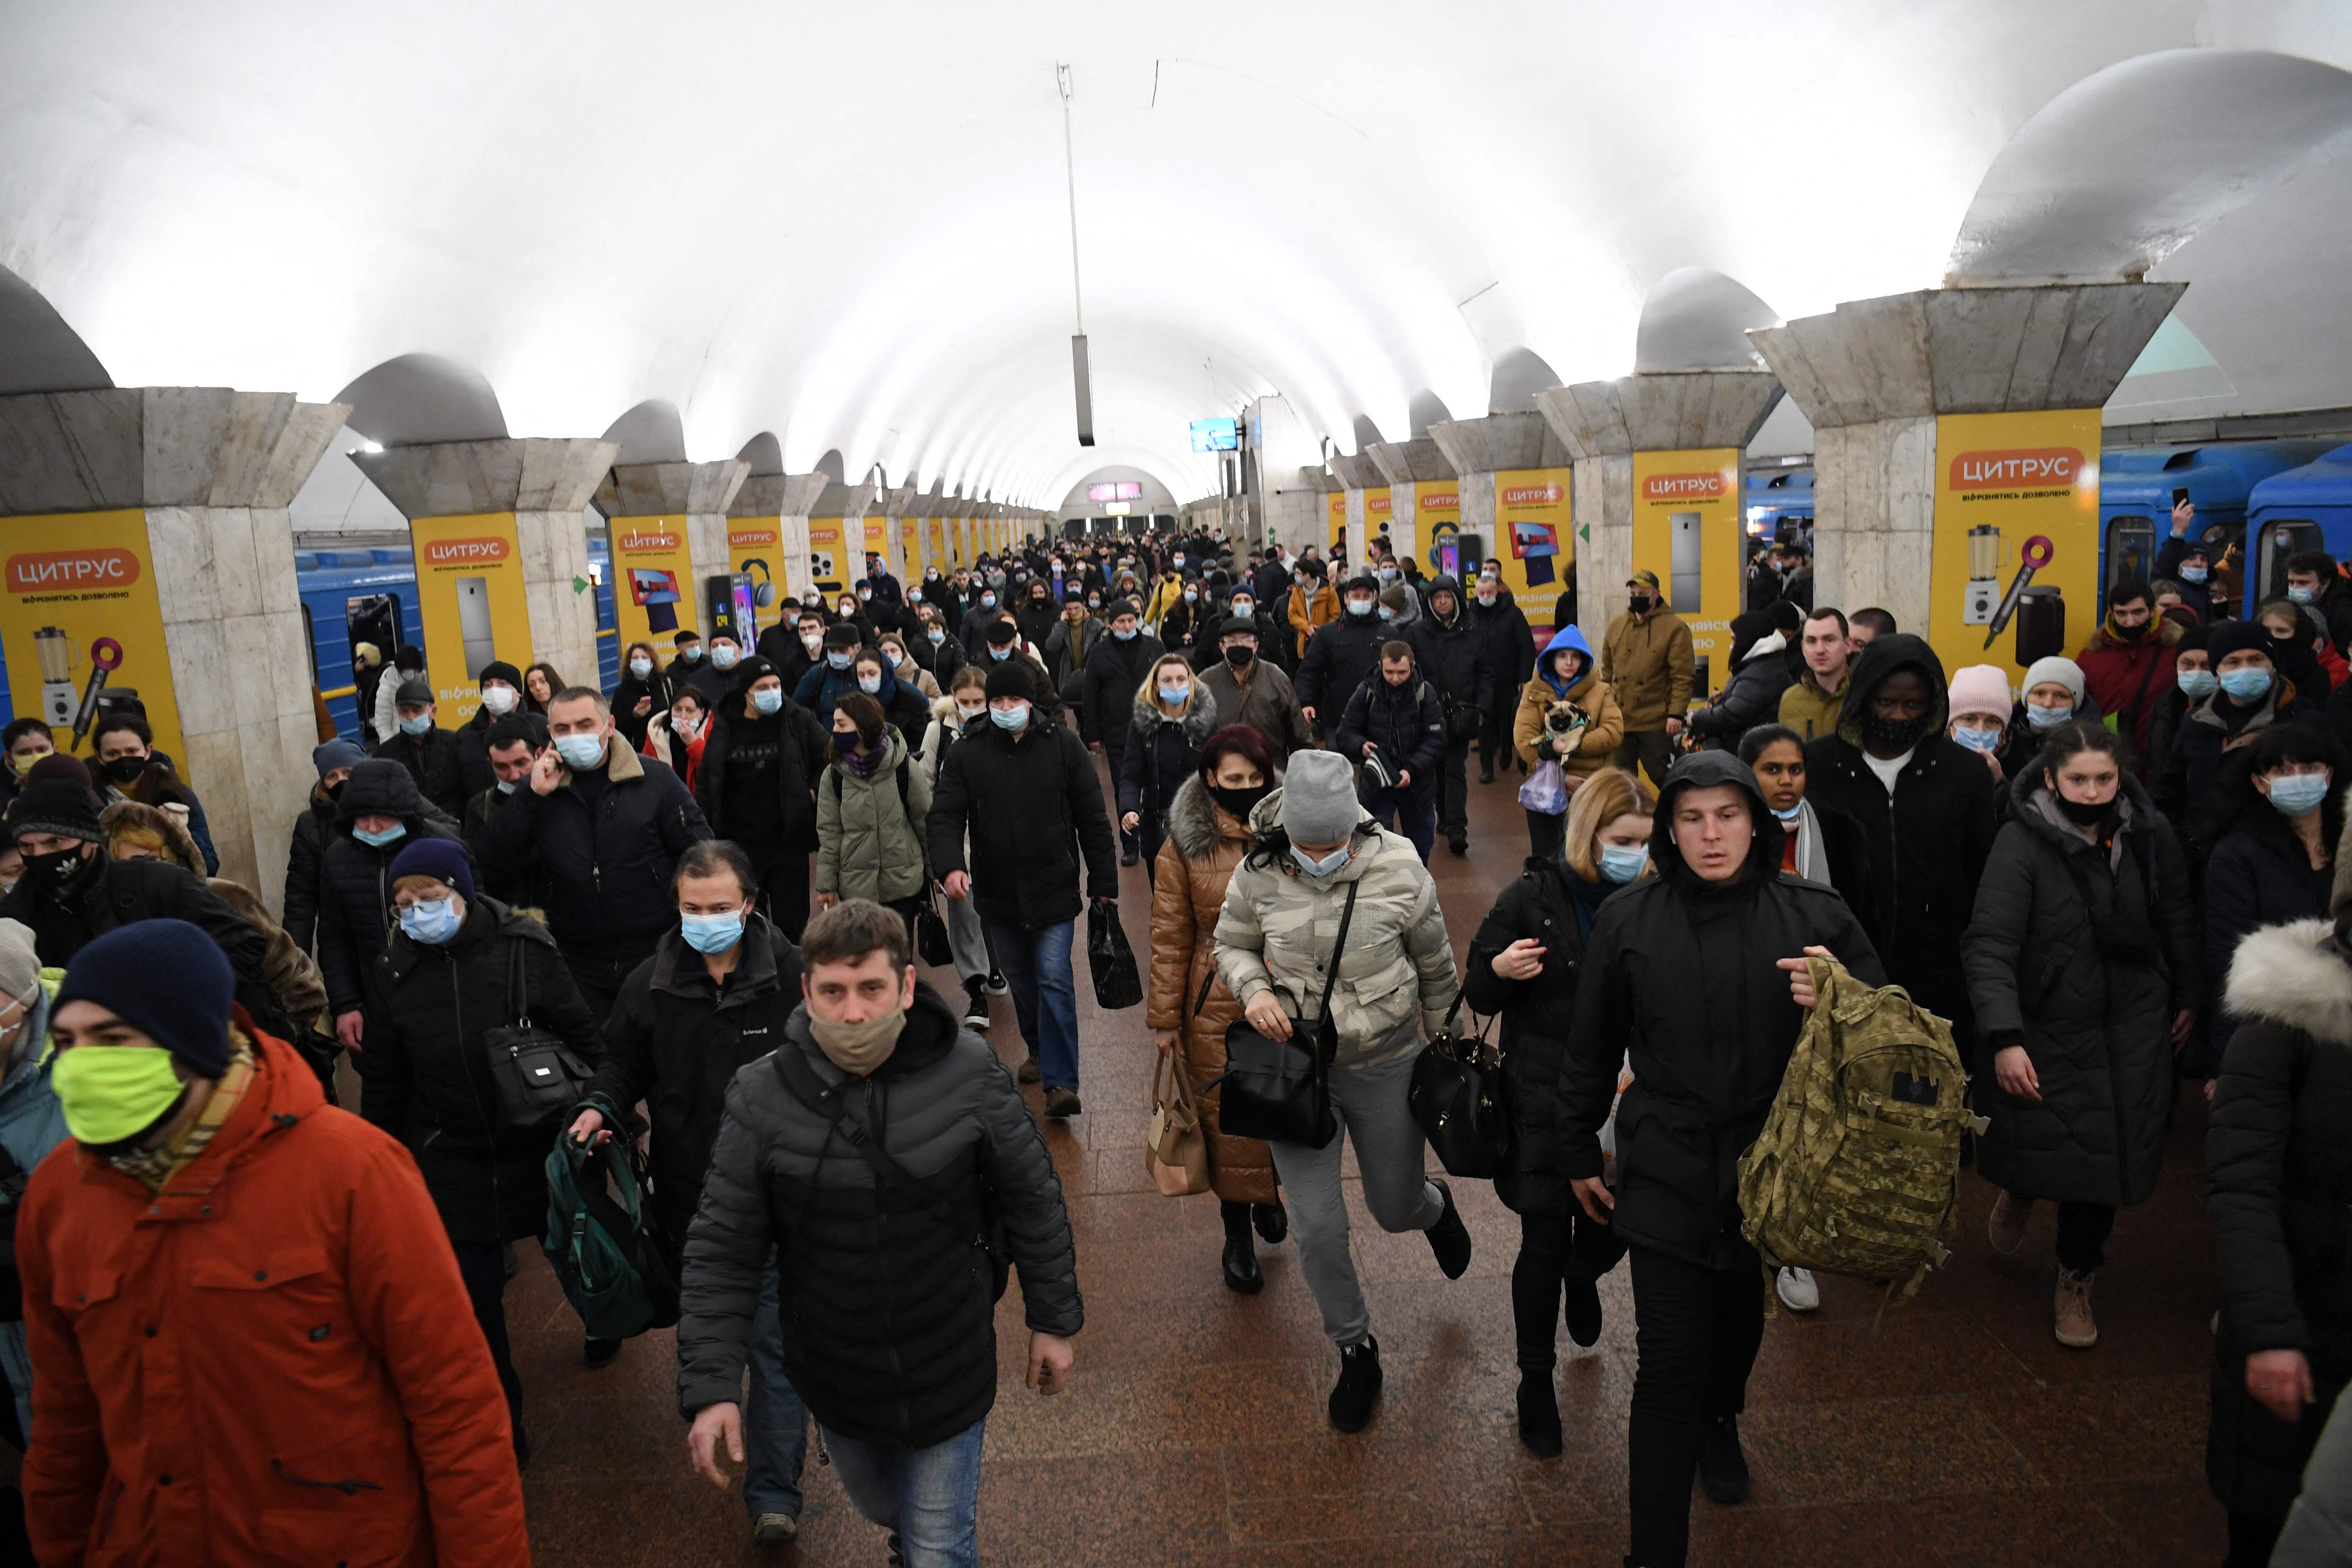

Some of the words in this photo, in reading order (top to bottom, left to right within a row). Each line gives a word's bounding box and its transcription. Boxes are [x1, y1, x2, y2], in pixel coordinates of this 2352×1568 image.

[1963, 457, 2069, 482] ЦИТРУС
[1651, 478, 1718, 494] ЦИТРУС
[1507, 489, 1557, 501] ЦИТРУС
[2023, 490, 2070, 499] ДОЗВОЛЕНО
[624, 536, 675, 548] ЦИТРУС
[732, 533, 771, 544] ЦИТРУС
[432, 542, 500, 559] ЦИТРУС
[17, 558, 124, 584] ЦИТРУС
[82, 591, 129, 601] ДОЗВОЛЕНО
